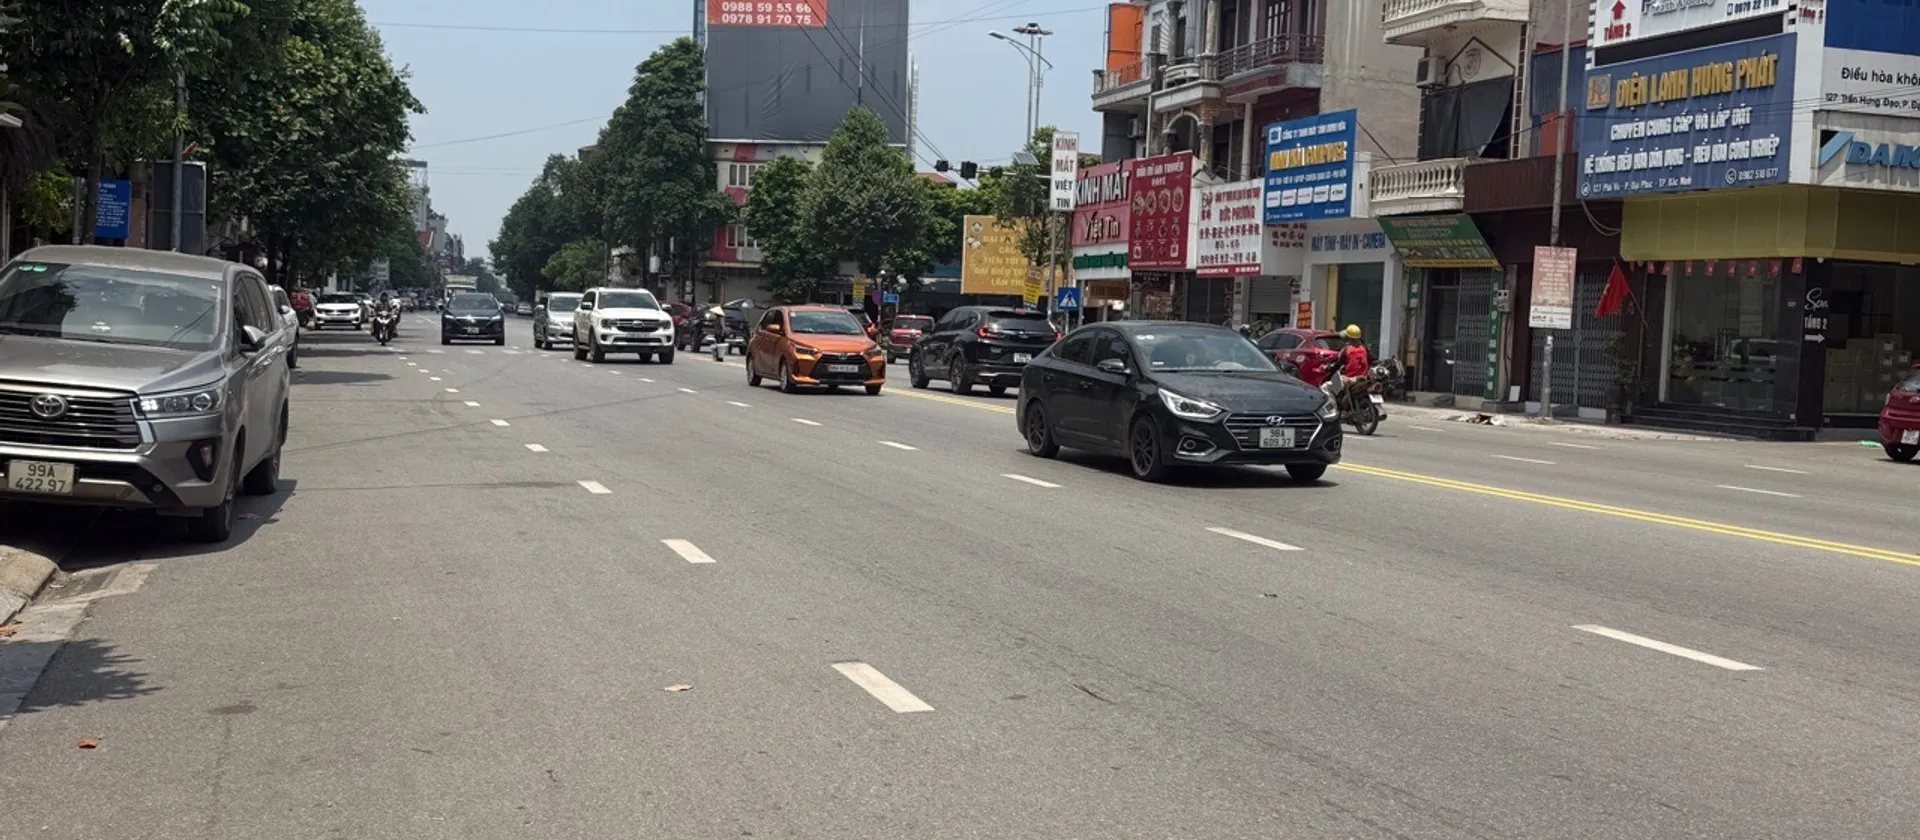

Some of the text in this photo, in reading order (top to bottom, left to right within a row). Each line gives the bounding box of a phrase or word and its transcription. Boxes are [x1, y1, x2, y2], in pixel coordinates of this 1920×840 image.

[722, 3, 811, 13] 0988 59 55 66
[722, 14, 811, 24] 0978 91 70 75
[1625, 23, 1631, 37] 2
[1616, 50, 1778, 111] ĐIỆN LẠNH HƯNG PHÁT
[1841, 67, 1868, 81] Điều
[1872, 69, 1893, 84] hòa
[1825, 93, 1838, 102] 127
[1646, 117, 1672, 136] CUNG
[1056, 135, 1077, 150] KÍNH
[1055, 180, 1073, 193] VIỆT
[1074, 159, 1131, 205] KÍNH MẮT
[1056, 198, 1070, 208] TIN
[1081, 212, 1102, 243] Việt
[1105, 215, 1120, 239] Tin
[1362, 232, 1386, 249] CAMERA
[1804, 287, 1828, 312] Spa
[1822, 318, 1827, 330] 2
[28, 463, 56, 478] 99A
[15, 478, 66, 492] 422.97
